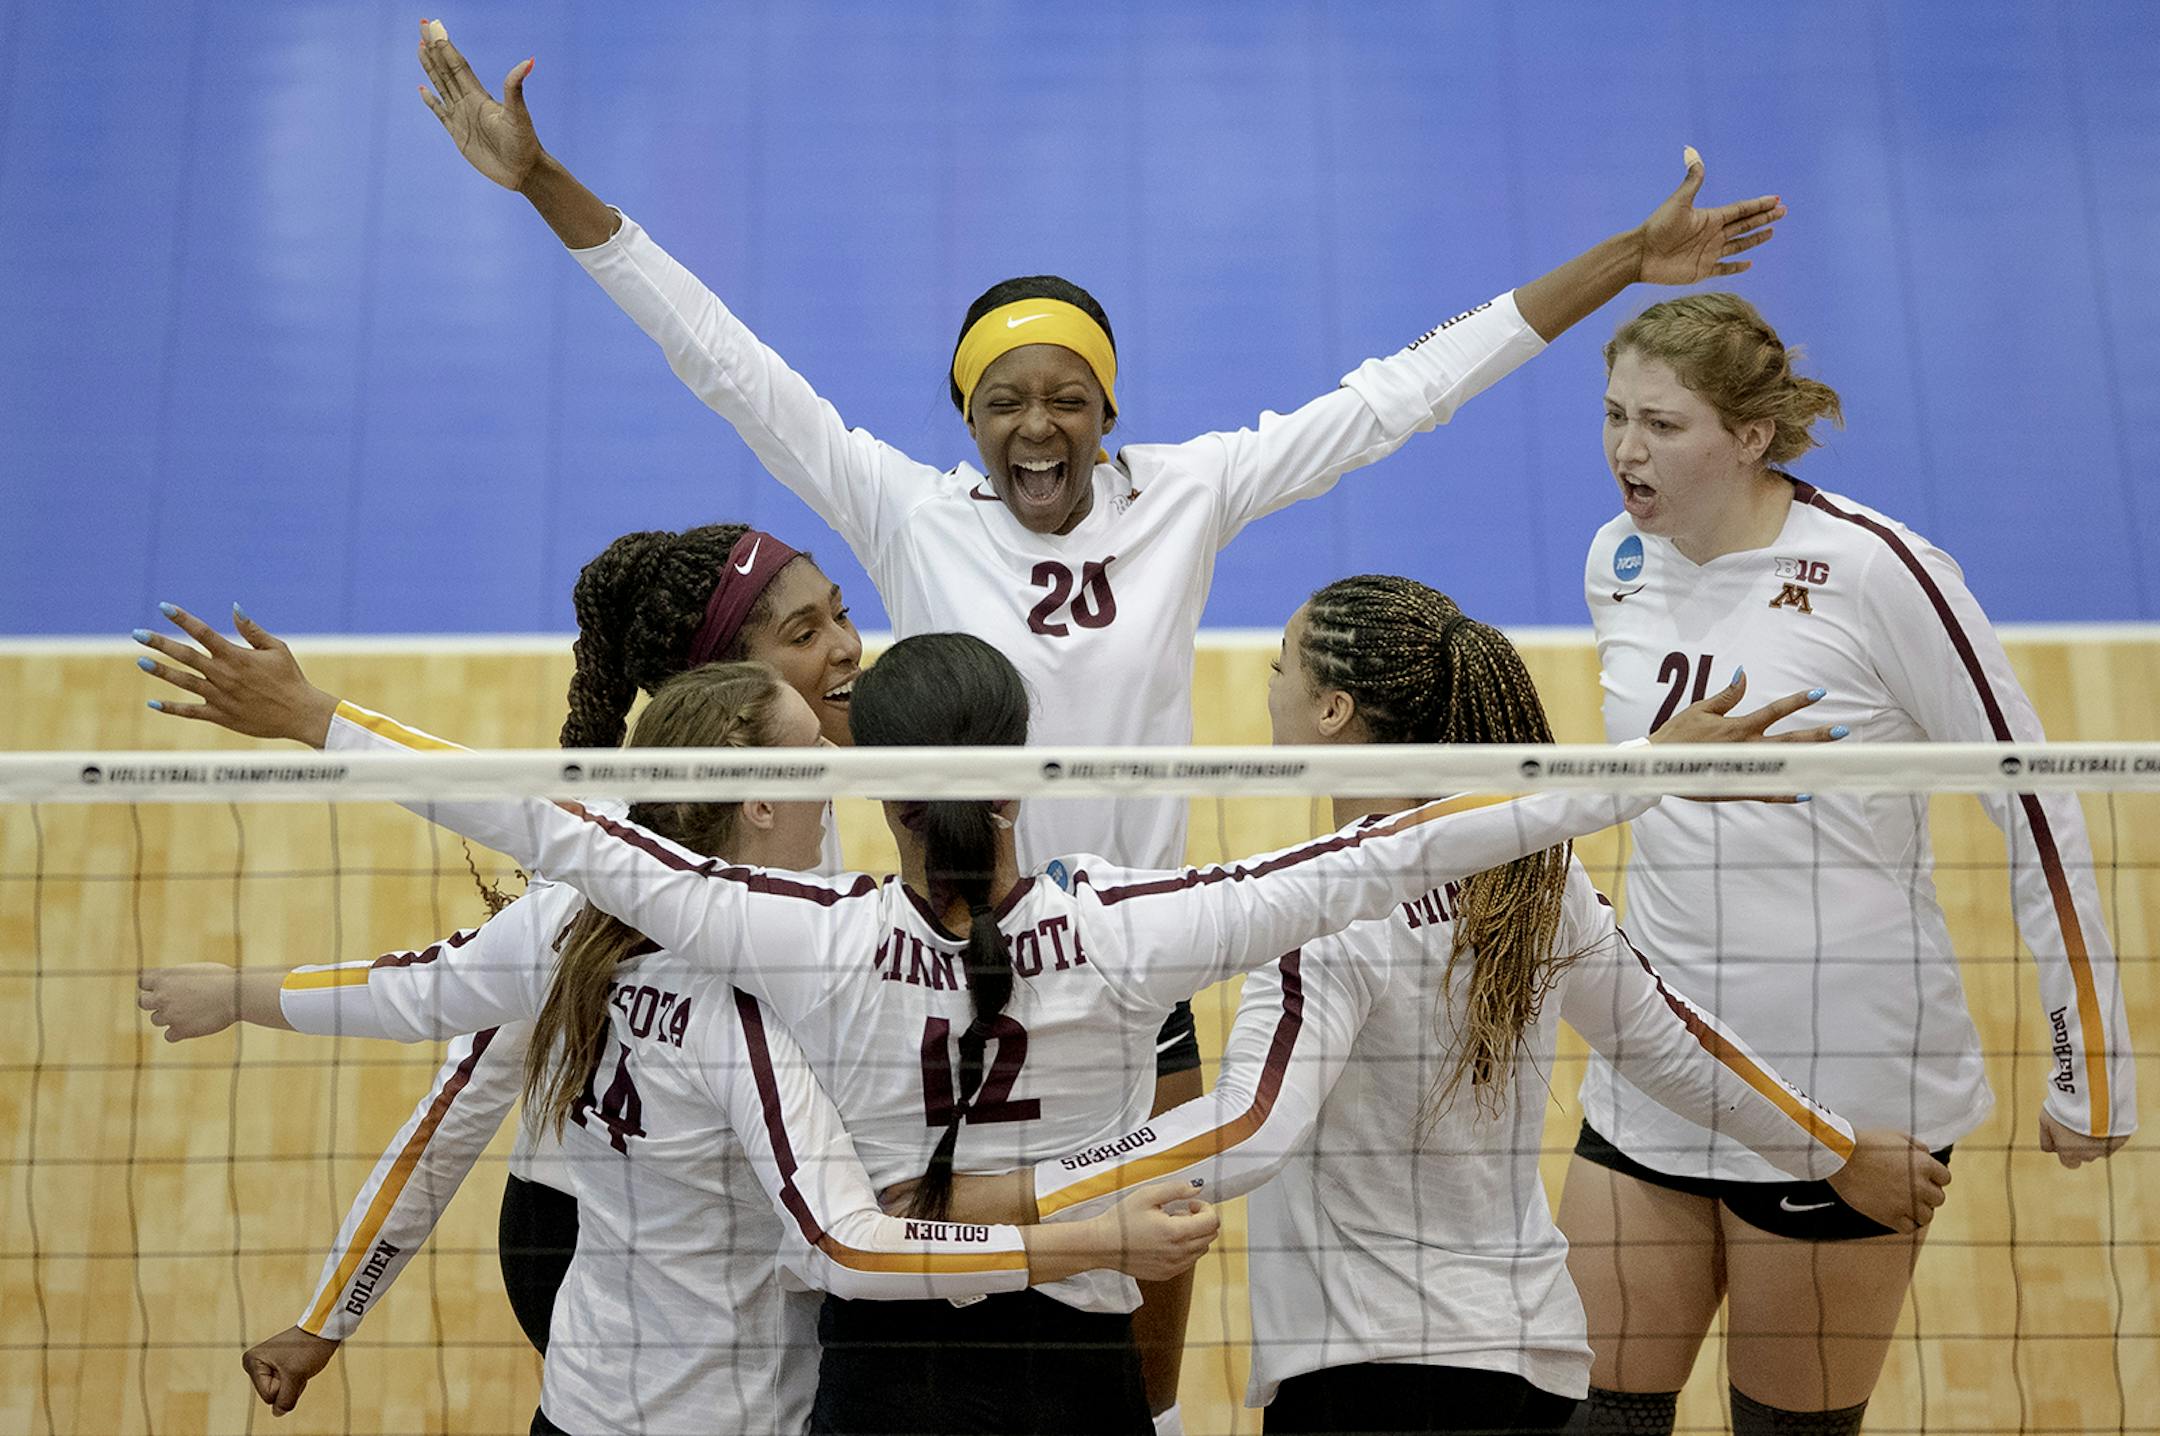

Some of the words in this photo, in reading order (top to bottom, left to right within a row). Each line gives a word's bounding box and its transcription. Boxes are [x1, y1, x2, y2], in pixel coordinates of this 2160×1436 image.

[1027, 555, 1117, 637] 20
[1769, 582, 1813, 615] M
[1650, 651, 1714, 735] 21
[108, 766, 207, 783] VOLLEYBALL
[213, 766, 347, 783] CHAMPIONSHIP
[590, 764, 689, 781] VOLLEYBALL
[695, 764, 827, 781] CHAMPIONSHIP
[1068, 762, 1168, 779] VOLLEYBALL
[1173, 762, 1306, 779] CHAMPIONSHIP
[1549, 759, 1647, 776] VOLLEYBALL
[1652, 759, 1786, 776] CHAMPIONSHIP
[2028, 757, 2127, 774] VOLLEYBALL
[920, 1013, 1041, 1128] 12
[1061, 1126, 1157, 1170] GOPHERS
[904, 1222, 989, 1242] GOLDEN
[345, 1239, 401, 1316] GOLDEN
